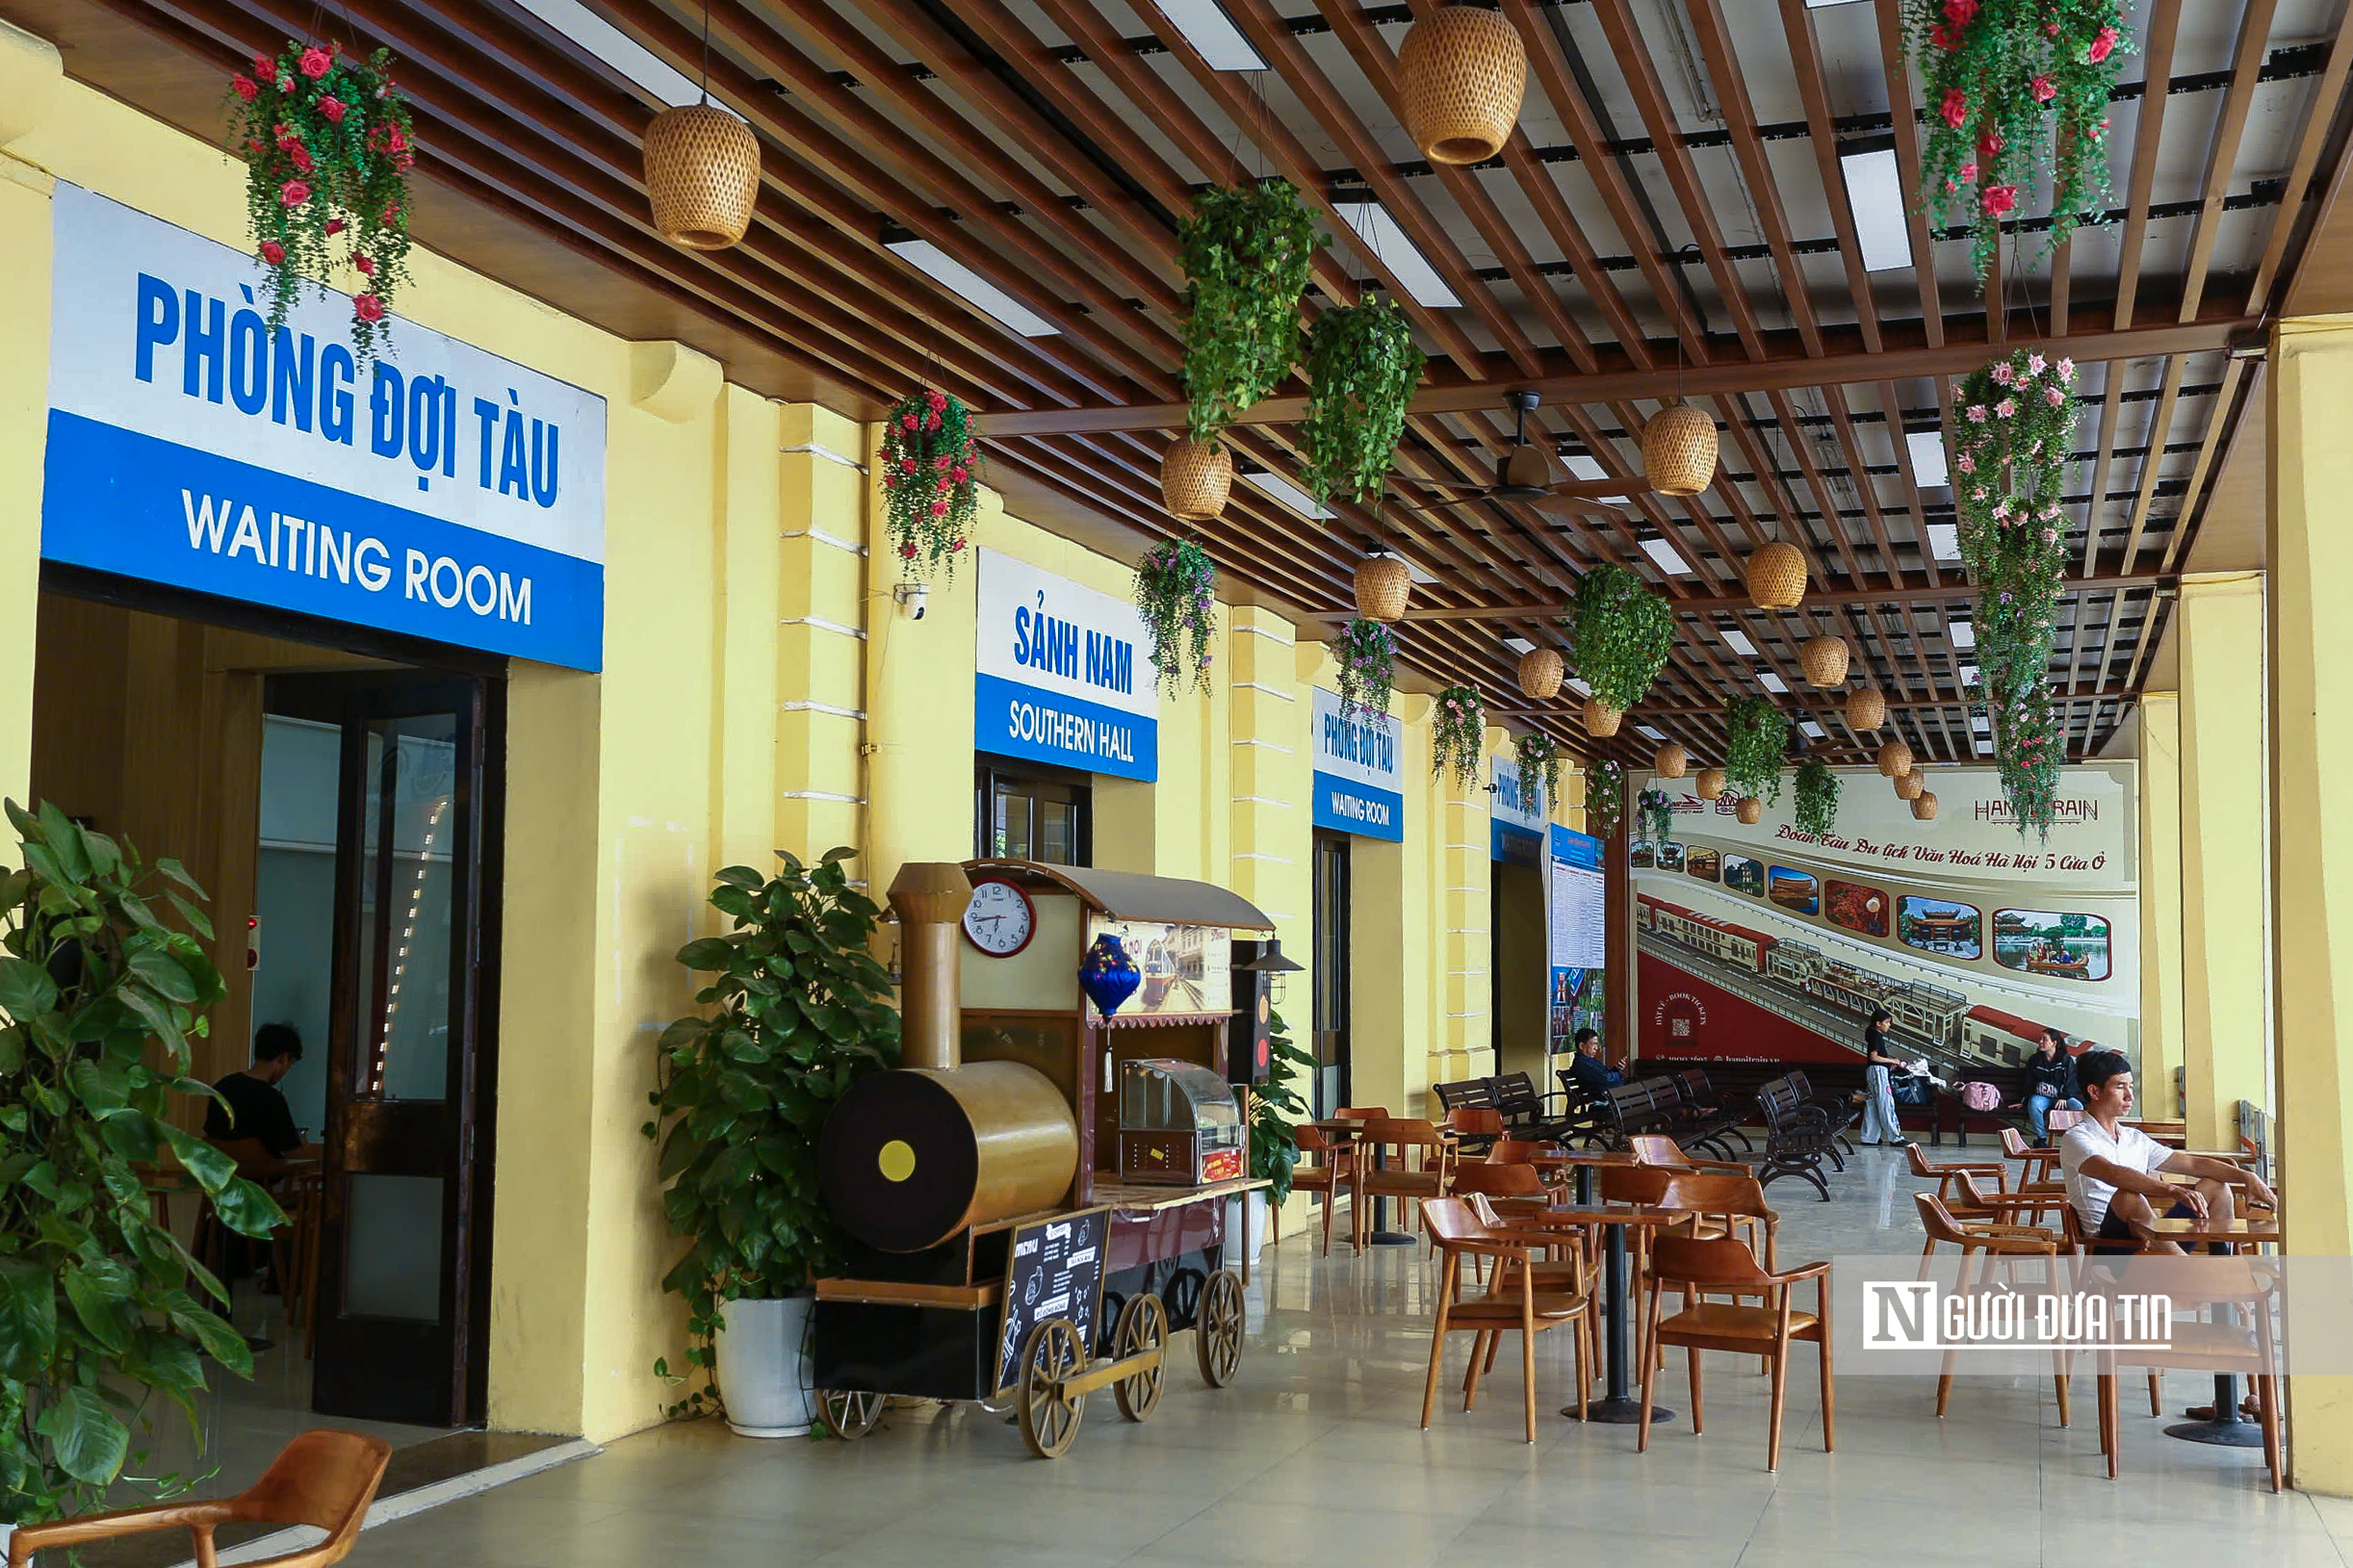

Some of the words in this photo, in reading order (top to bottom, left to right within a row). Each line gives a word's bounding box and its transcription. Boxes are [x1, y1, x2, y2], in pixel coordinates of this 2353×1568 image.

[135, 271, 354, 446] PHÒNG
[370, 360, 455, 491] ĐỢI
[474, 388, 558, 507] TÀU
[181, 488, 391, 591] WAITING
[404, 548, 531, 625] ROOM
[1014, 589, 1078, 680] SẢNH
[1086, 630, 1132, 695] NAM
[1009, 700, 1095, 754] SOUTHERN
[1099, 722, 1134, 762] HALL
[1331, 791, 1365, 821] WAITING
[1366, 800, 1390, 826] ROOM
[1975, 800, 2028, 820] HAN
[2049, 800, 2098, 820] RAIN
[1912, 846, 1944, 862] Văn
[1984, 852, 2010, 868] Hà
[2012, 853, 2039, 873] Nội
[2045, 853, 2056, 869] 5
[982, 889, 988, 898] 11
[993, 887, 1001, 895] 12
[1008, 889, 1011, 898] 1
[973, 900, 982, 909] 10
[1016, 899, 1023, 909] 2
[1021, 913, 1028, 921] 3
[975, 926, 983, 935] 8
[1019, 925, 1024, 935] 4
[986, 934, 992, 943] 7
[1011, 935, 1018, 943] 5
[998, 939, 1006, 948] 6
